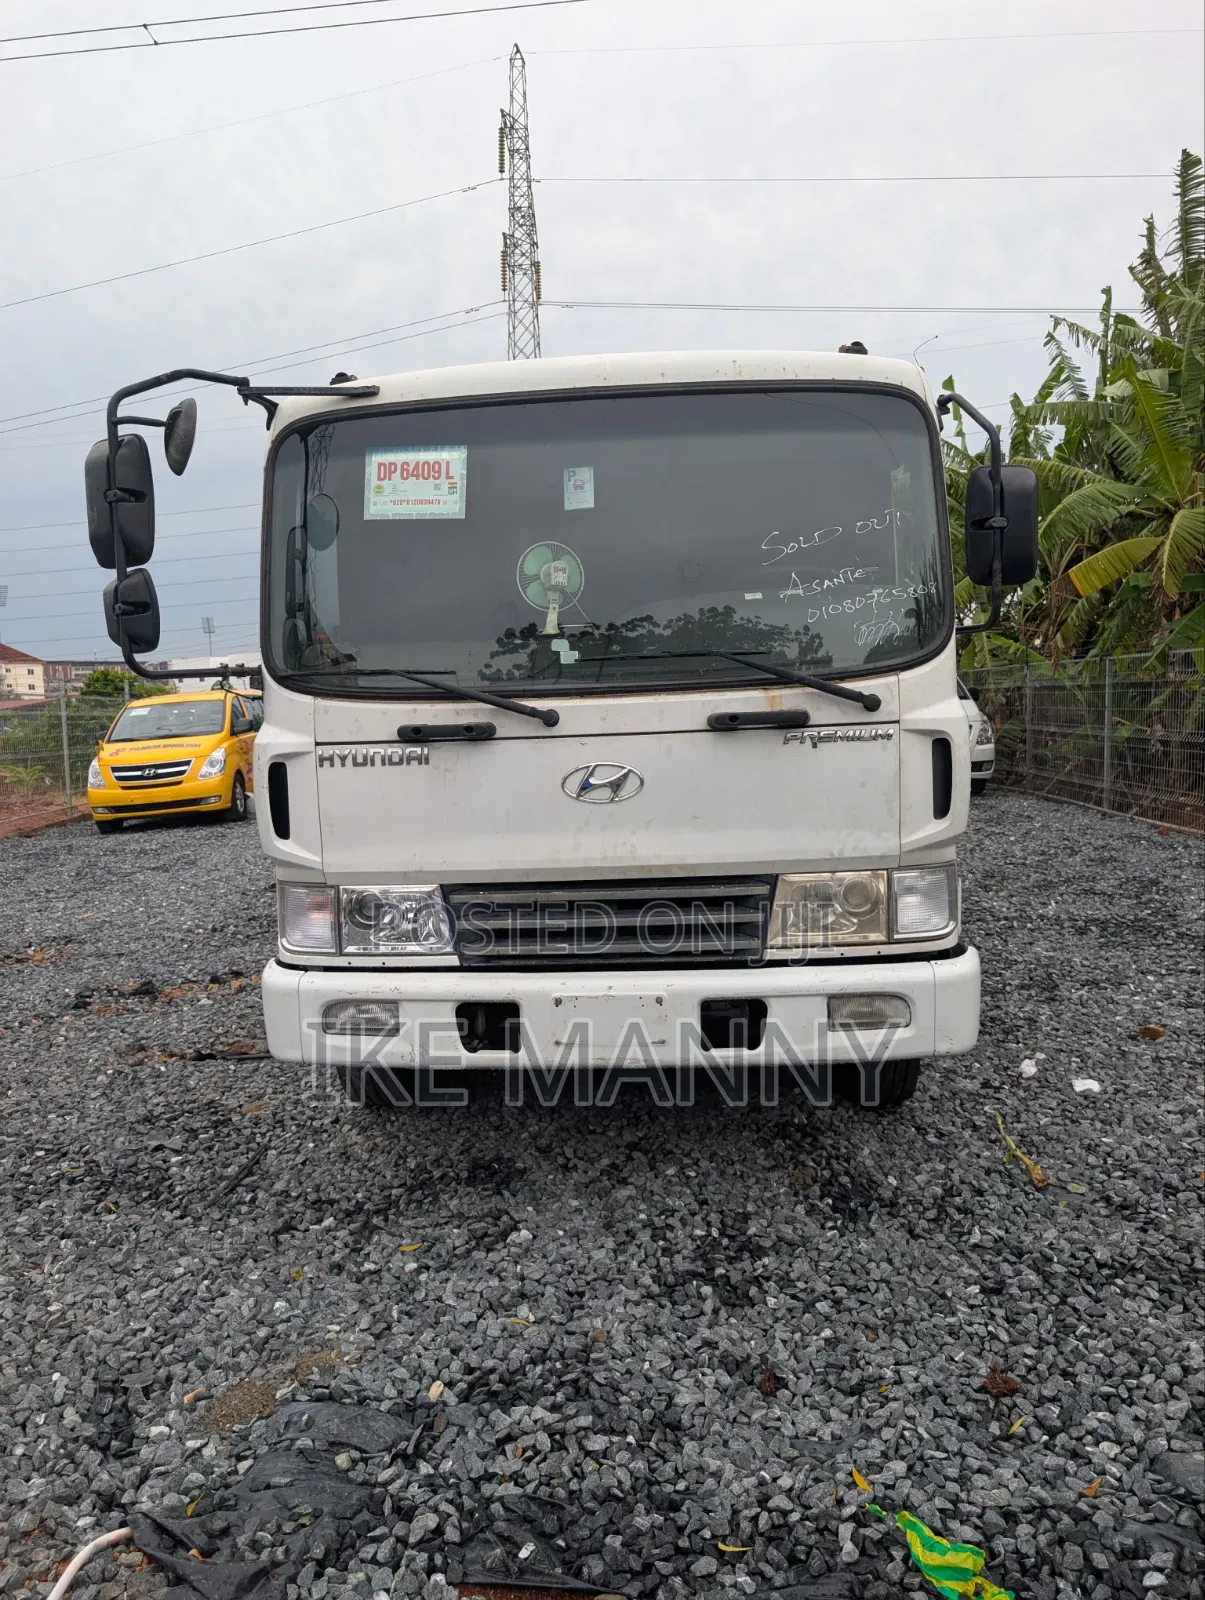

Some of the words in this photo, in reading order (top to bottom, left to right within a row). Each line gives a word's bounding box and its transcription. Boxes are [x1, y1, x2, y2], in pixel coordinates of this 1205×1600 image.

[377, 462, 398, 482] DP
[400, 460, 442, 481] 6409
[445, 460, 455, 480] L
[783, 728, 895, 749] PREMIUM
[318, 747, 430, 768] HYUNDAI
